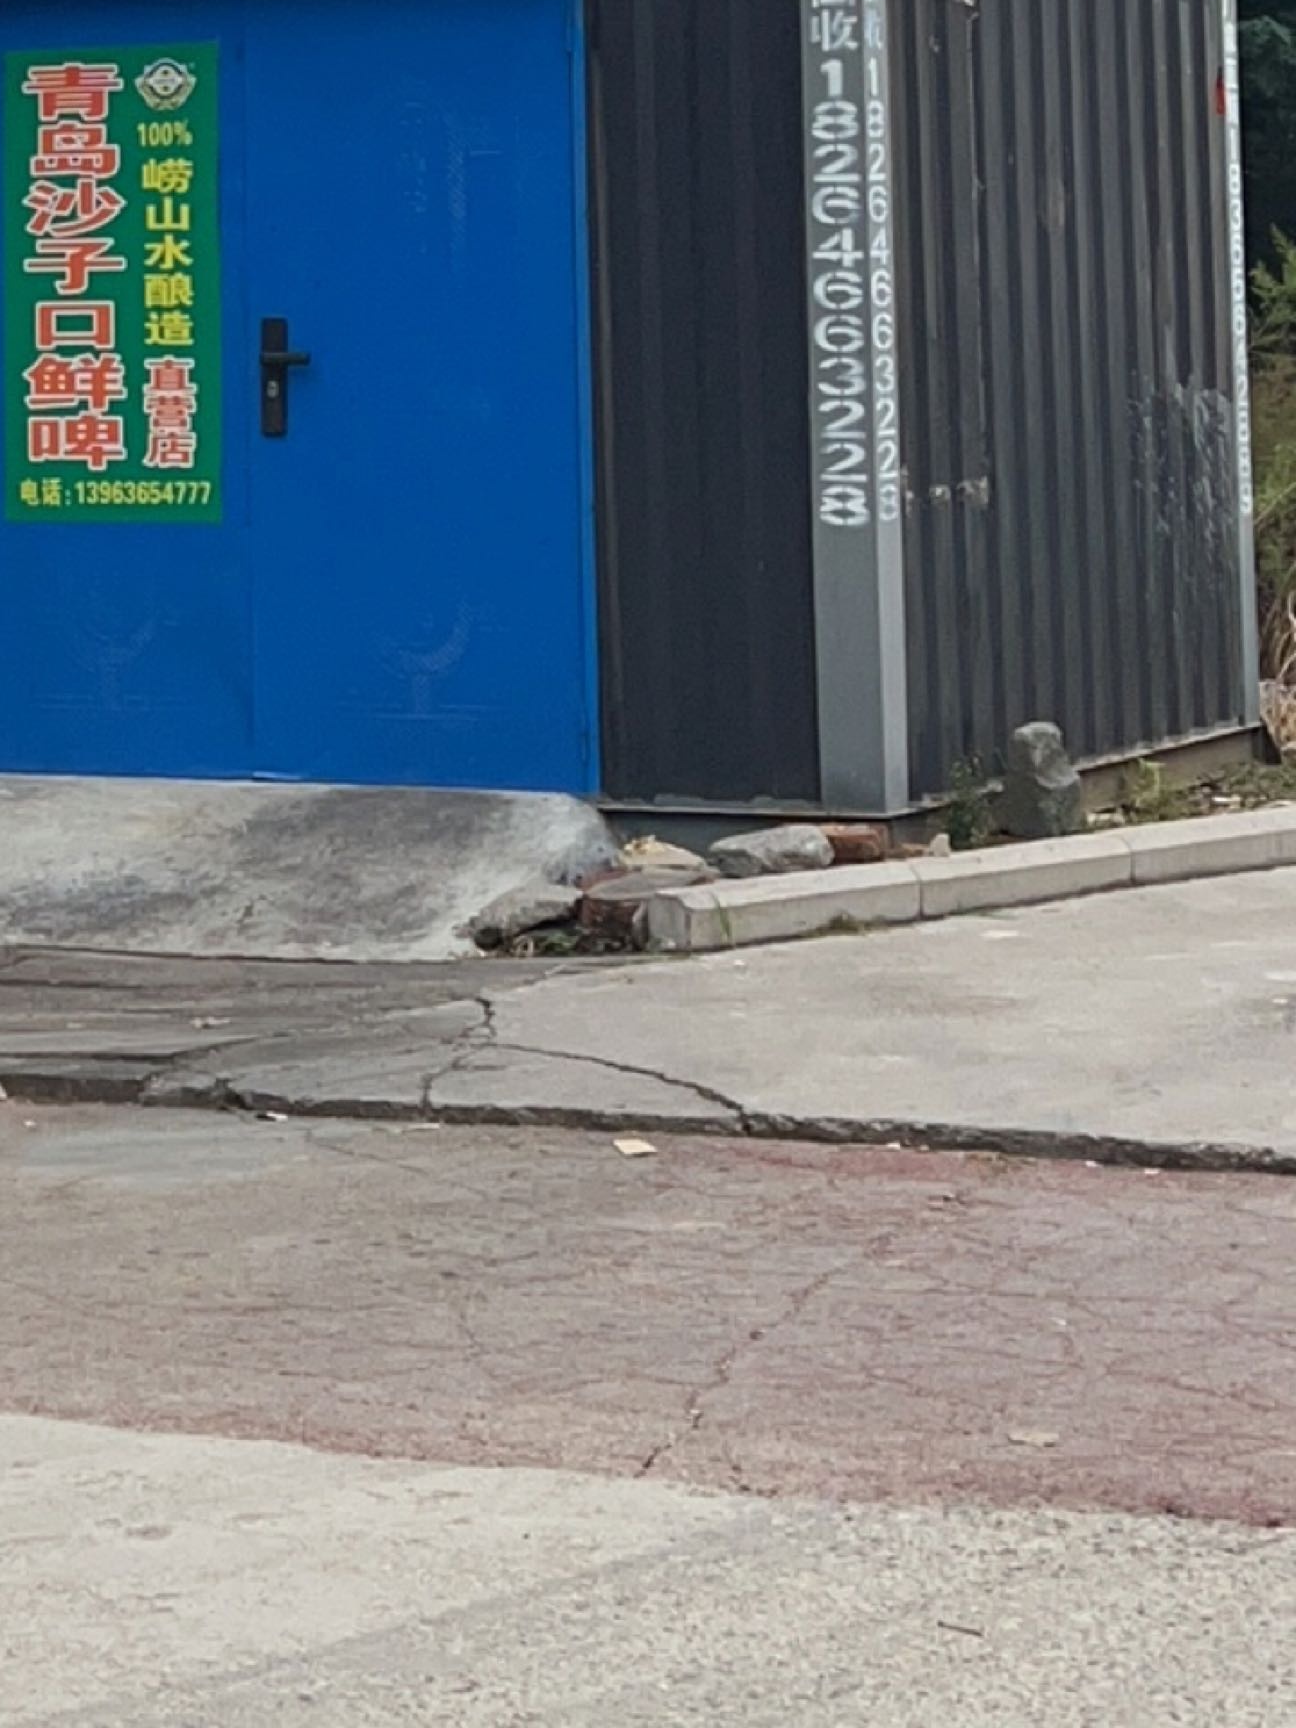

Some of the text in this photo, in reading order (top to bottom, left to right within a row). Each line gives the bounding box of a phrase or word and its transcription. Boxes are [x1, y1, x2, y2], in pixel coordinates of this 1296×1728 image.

[137, 120, 193, 147] 100%
[22, 62, 127, 471] 青岛沙子口鲜啤
[141, 157, 195, 347] 崂山水酿造
[143, 355, 196, 469] 直营店
